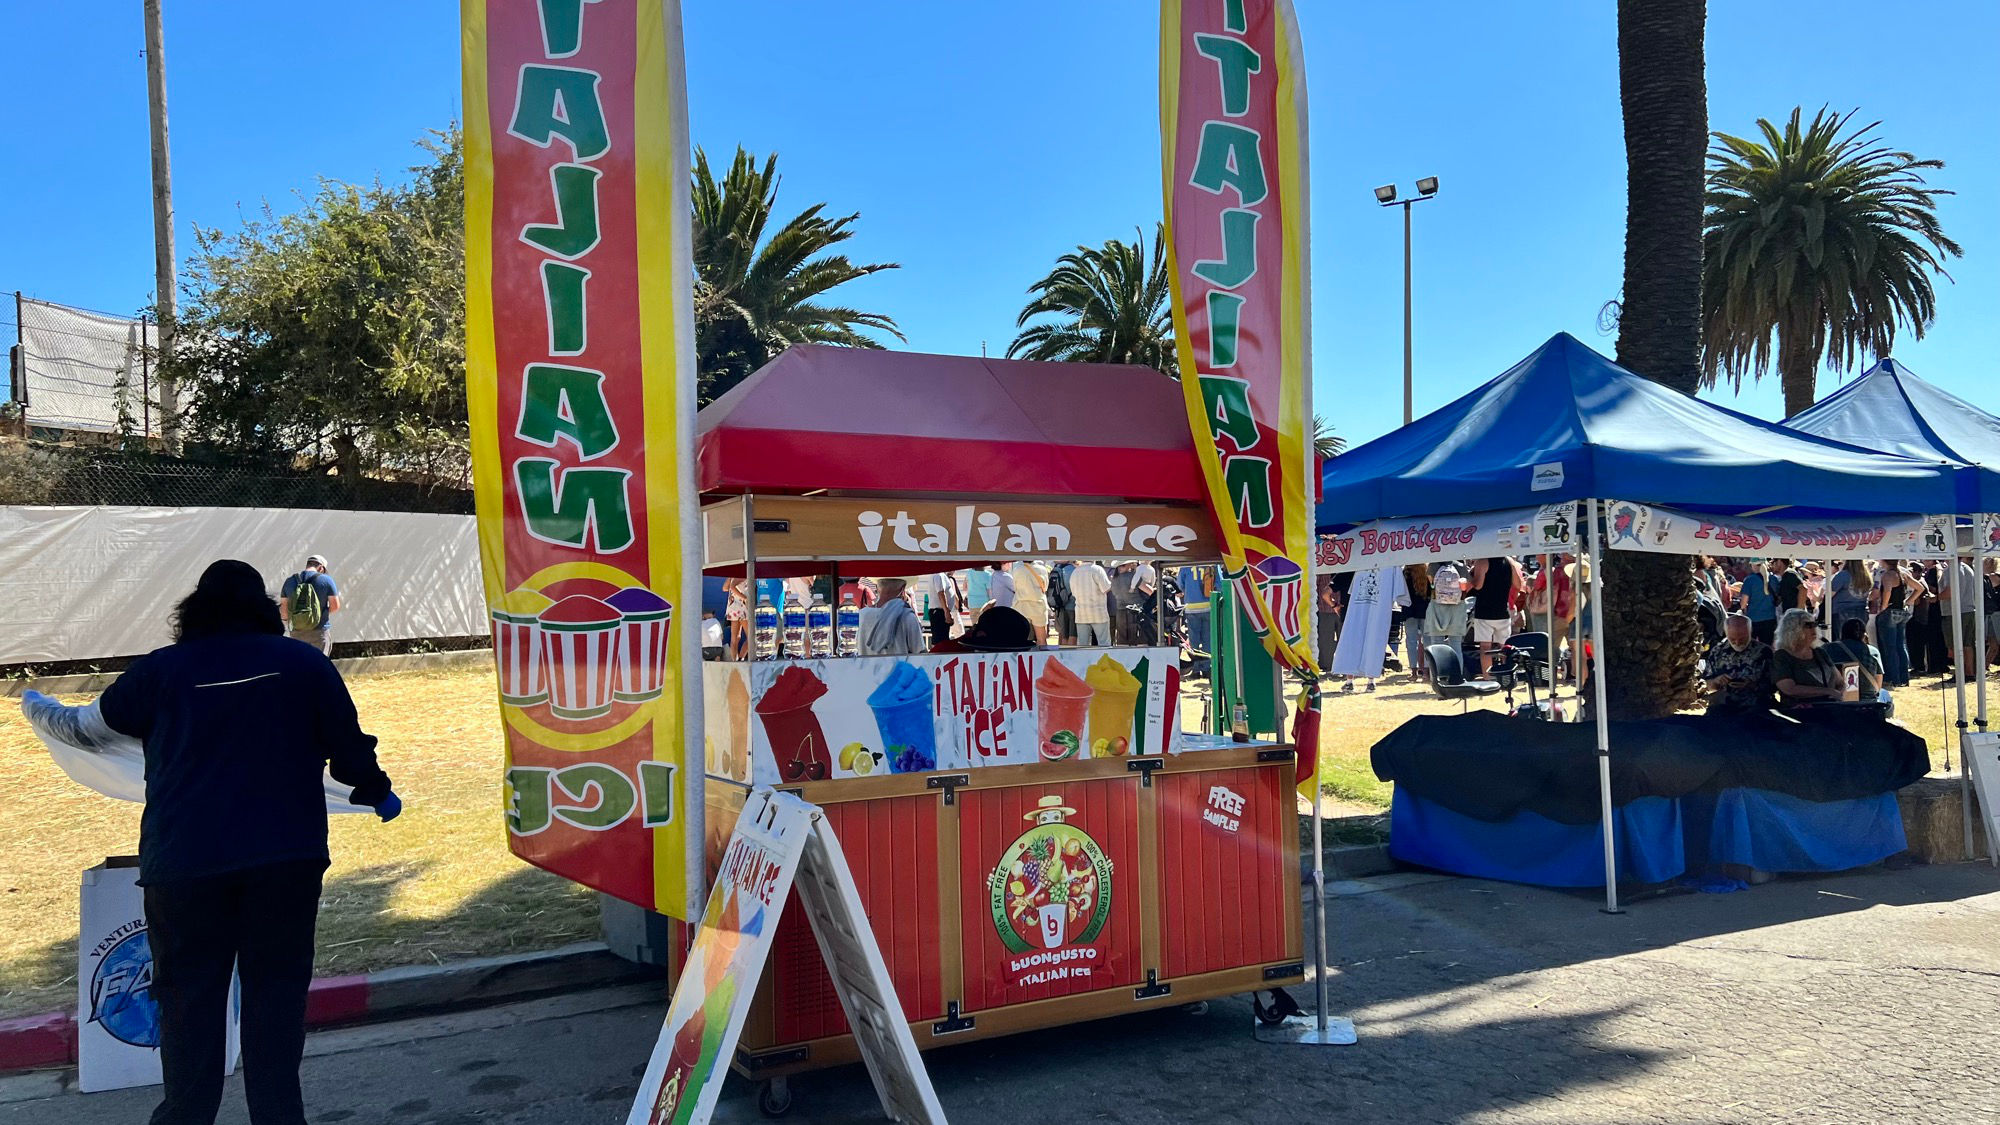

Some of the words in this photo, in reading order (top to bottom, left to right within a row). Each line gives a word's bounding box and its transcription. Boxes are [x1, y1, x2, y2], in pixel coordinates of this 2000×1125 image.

[857, 505, 1071, 553] italian
[1106, 513, 1198, 554] ice
[1360, 523, 1477, 555] Boutique
[1208, 786, 1246, 817] FREE
[995, 865, 1009, 890] FREE
[1085, 841, 1100, 859] 100%
[1096, 859, 1109, 917] CHOLESTEROL
[994, 894, 1002, 909] FAT
